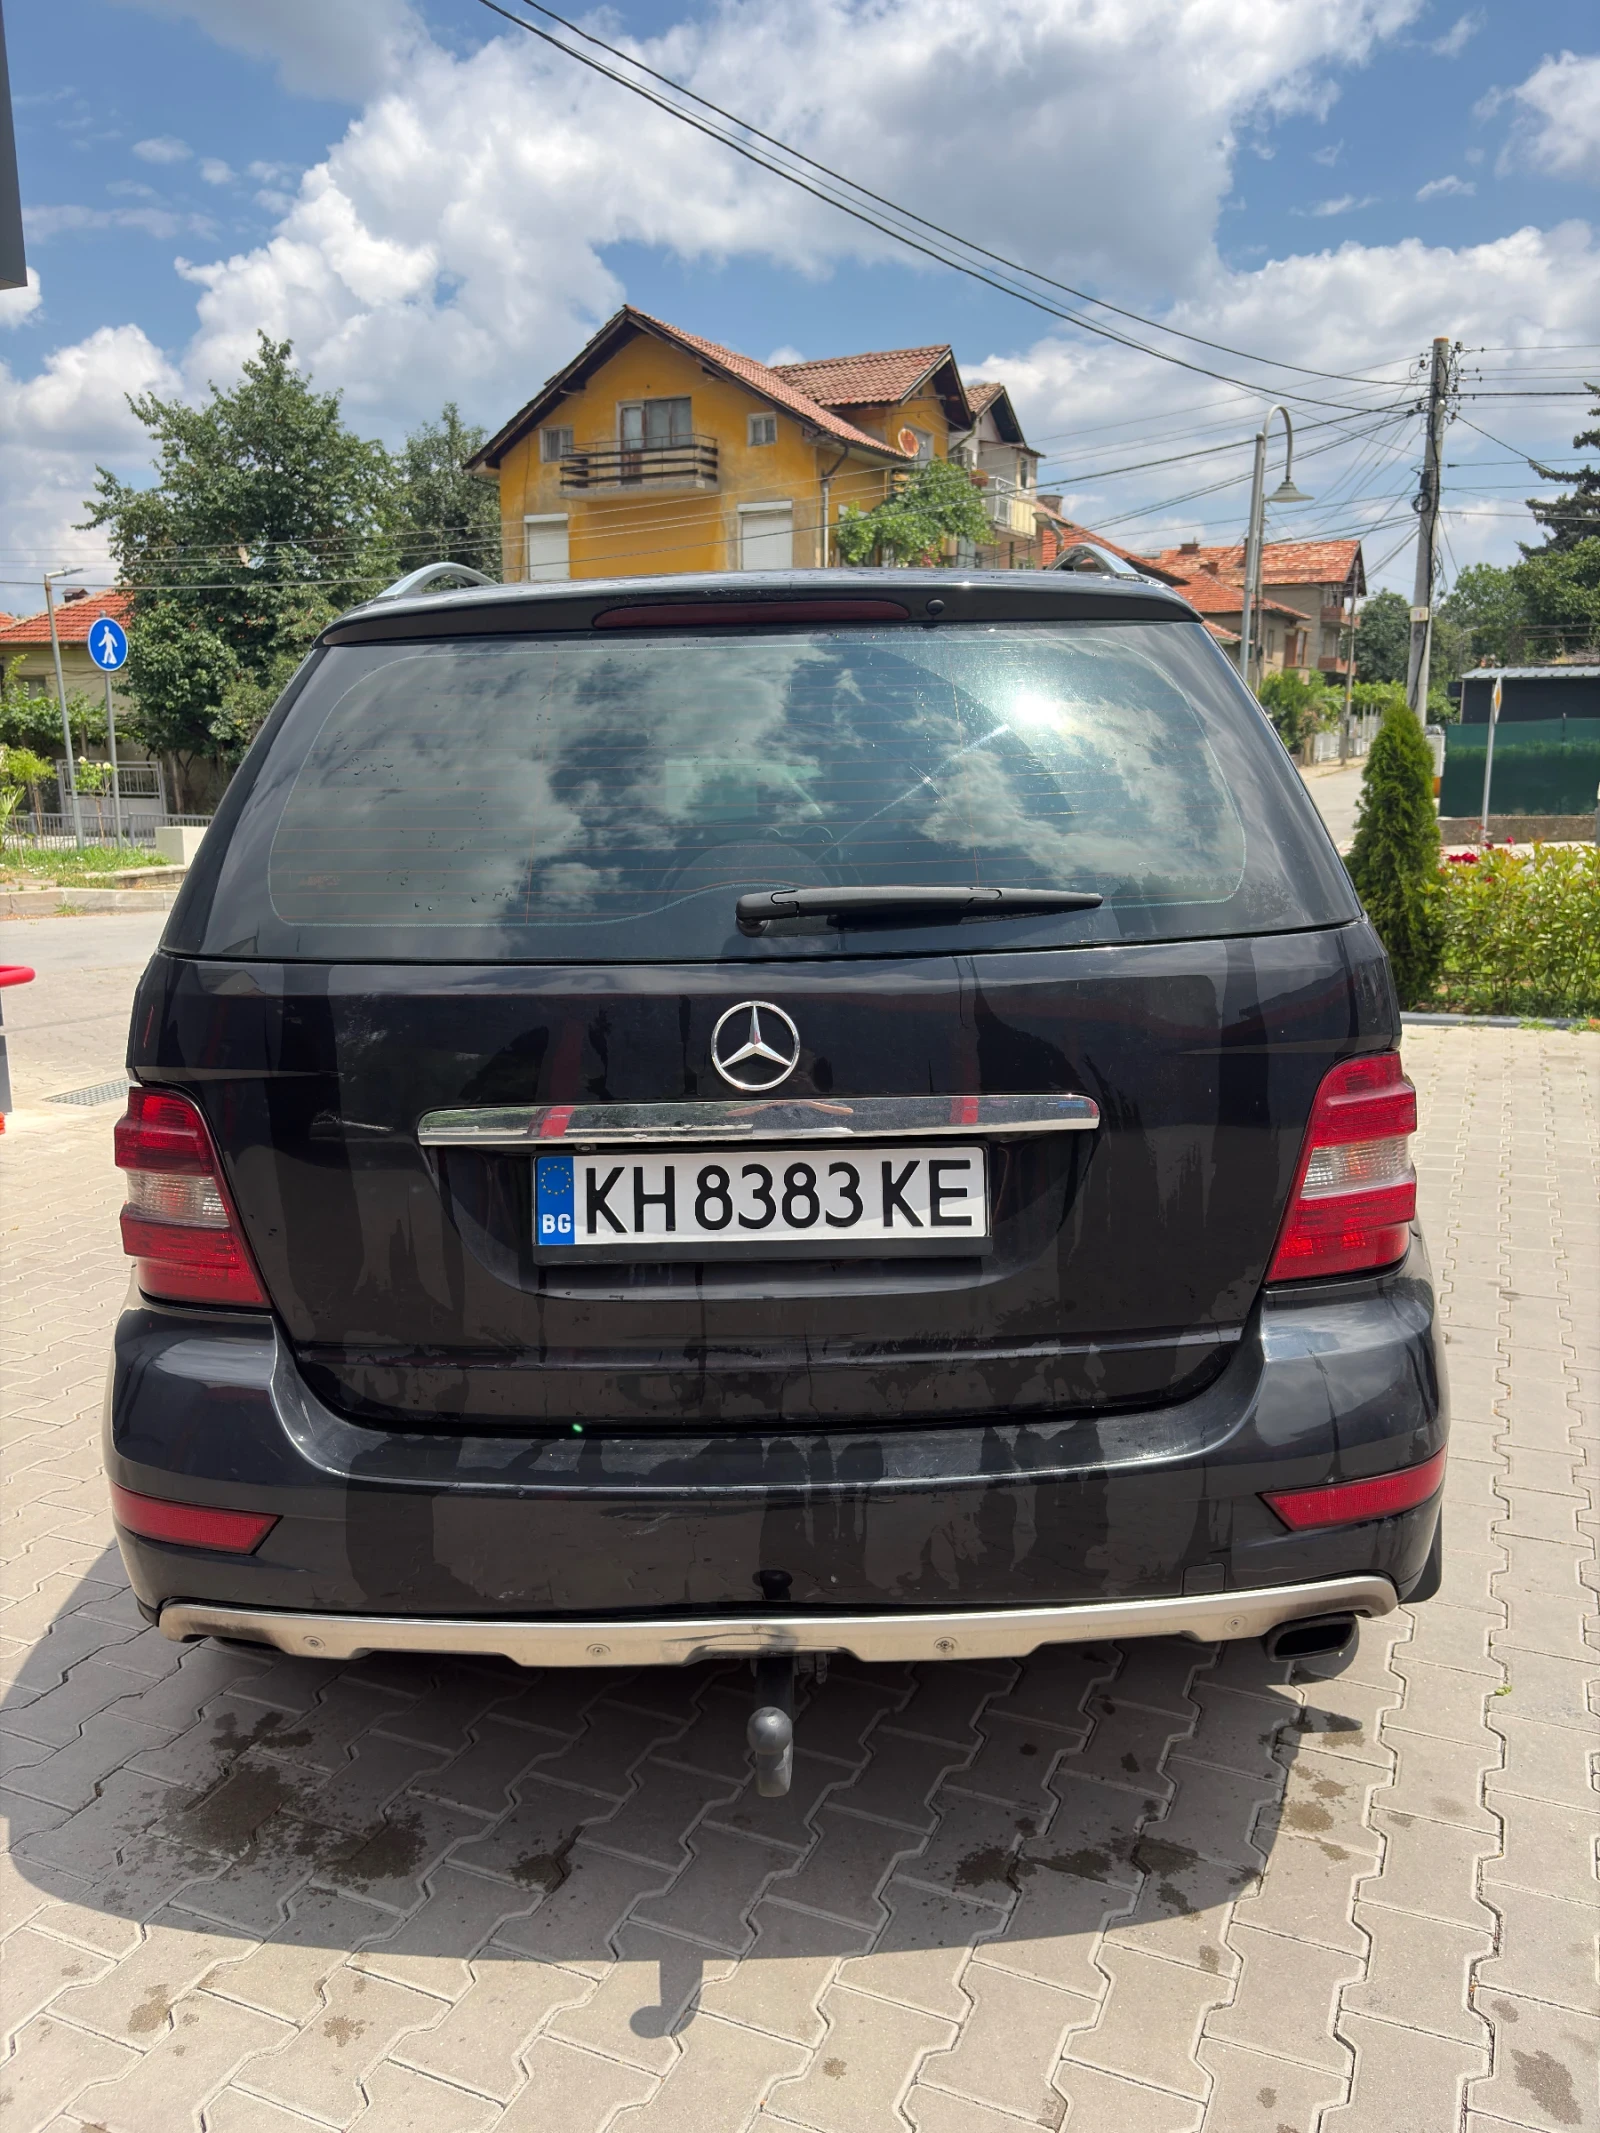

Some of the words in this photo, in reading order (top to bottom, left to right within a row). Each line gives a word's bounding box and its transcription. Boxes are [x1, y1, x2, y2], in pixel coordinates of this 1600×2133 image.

[586, 1166, 676, 1233] KH
[695, 1162, 863, 1230] 8383
[882, 1160, 972, 1227] KE
[542, 1213, 571, 1234] BG
